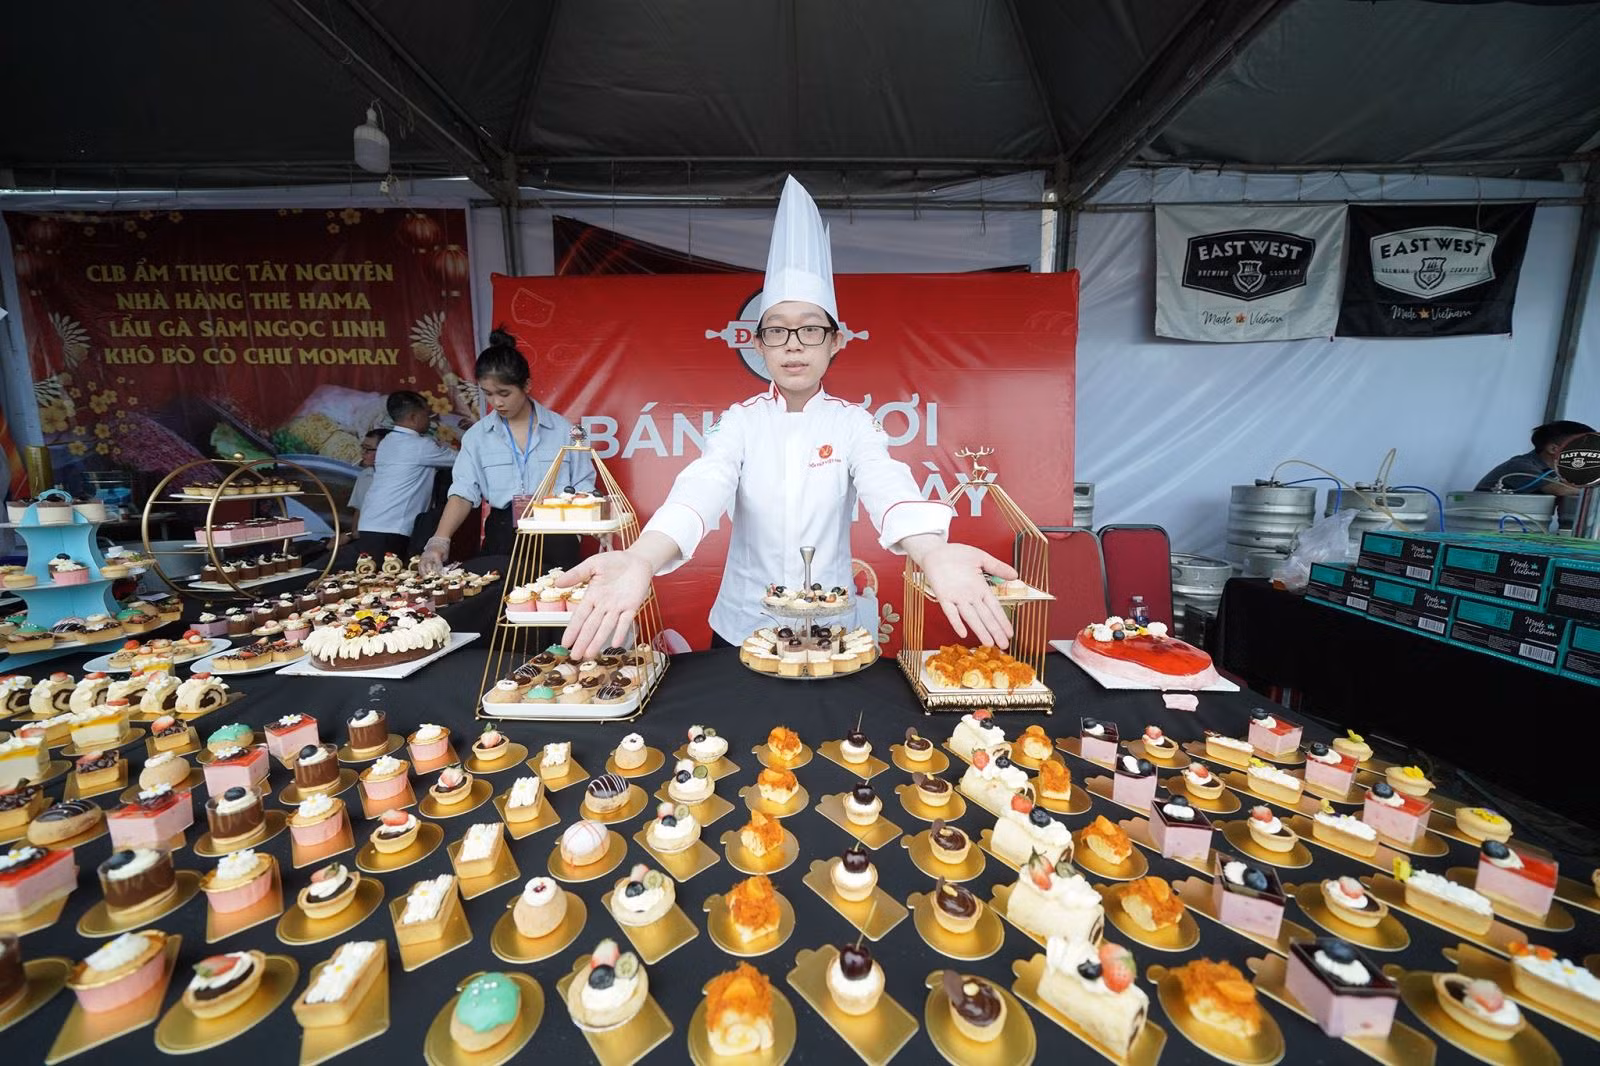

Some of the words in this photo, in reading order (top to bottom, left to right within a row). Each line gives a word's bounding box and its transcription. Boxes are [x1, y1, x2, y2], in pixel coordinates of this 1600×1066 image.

[1198, 241, 1246, 261] EAST
[1248, 240, 1303, 260] WEST
[1380, 238, 1430, 259] EAST
[1434, 237, 1486, 256] WEST
[86, 264, 127, 282] CLB
[133, 257, 170, 282] ẨM
[175, 264, 241, 285] THỰC
[245, 260, 289, 281] TÂY
[295, 260, 394, 281] NGUYÊN
[115, 289, 170, 310] NHÀ
[175, 289, 245, 310] HÀNG
[250, 292, 292, 310] THE
[298, 292, 372, 310] HAMA
[1202, 310, 1233, 326] Made
[1249, 311, 1284, 326] Vietnam
[1391, 304, 1417, 320] Made
[1431, 306, 1473, 321] Vietnam
[109, 313, 153, 338] LẨU
[158, 316, 194, 338] GÀ
[198, 317, 248, 338] SÂM
[254, 319, 326, 341] NGỌC
[332, 320, 386, 338] LINH
[104, 344, 155, 365] KHÔ
[161, 344, 196, 365] BÒ
[203, 342, 236, 365] CỎ
[243, 347, 293, 365] CHƯ
[299, 347, 400, 366] MOMRAY
[581, 401, 715, 459] BÁN
[862, 393, 938, 447] ƠI
[1509, 558, 1530, 570] Made
[1513, 565, 1541, 577] Vietnam
[1524, 616, 1546, 628] Made
[1528, 624, 1557, 637] Vietnam
